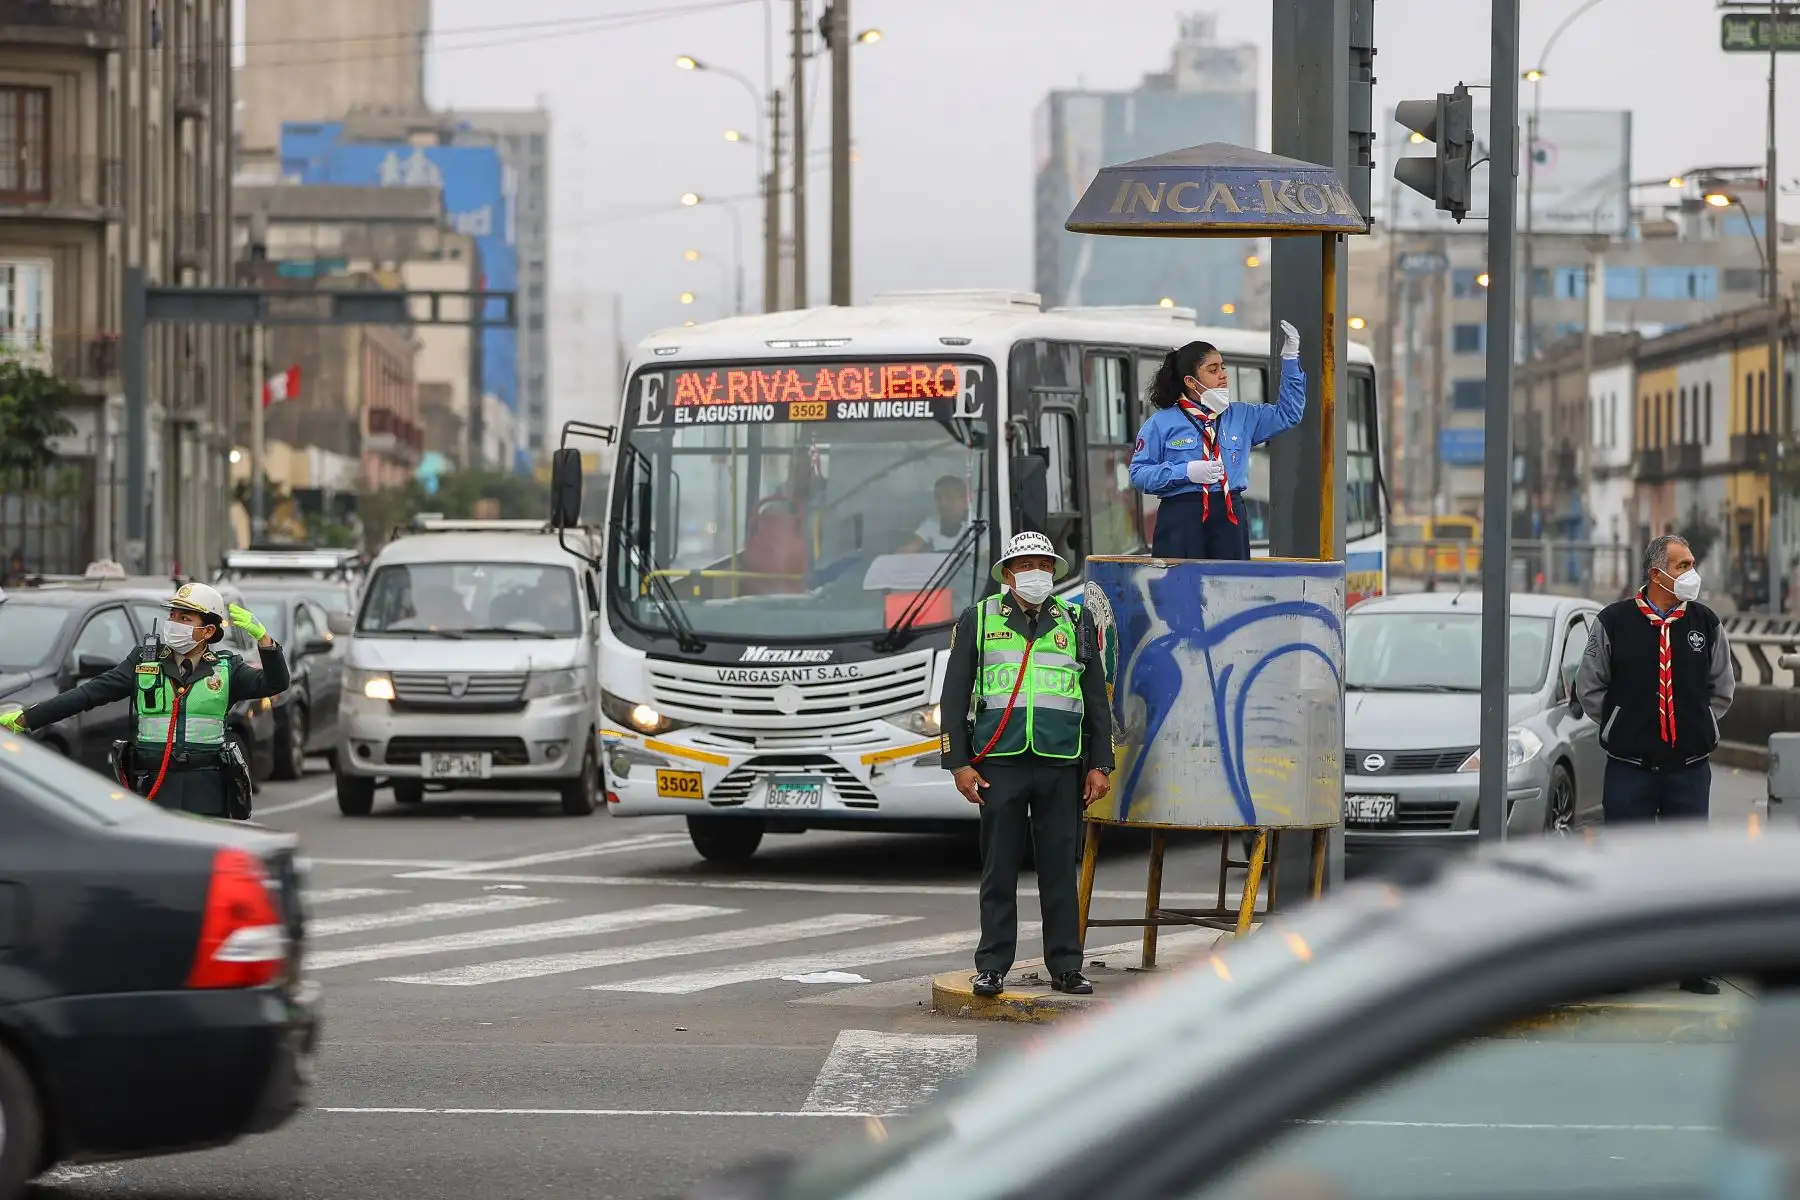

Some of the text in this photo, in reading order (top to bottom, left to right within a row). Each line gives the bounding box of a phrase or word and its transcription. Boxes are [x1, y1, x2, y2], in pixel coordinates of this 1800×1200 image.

[1109, 179, 1241, 214] INCA
[813, 364, 960, 402] AGUERO
[952, 364, 985, 419] E
[637, 373, 665, 426] E
[674, 404, 775, 424] EL AGUSTINO
[791, 403, 824, 418] 3502
[836, 401, 935, 420] SAN MIGUEL
[1014, 532, 1051, 546] POLICIA
[717, 665, 864, 683] VARGASANT S.A.C.
[659, 775, 700, 794] 3502
